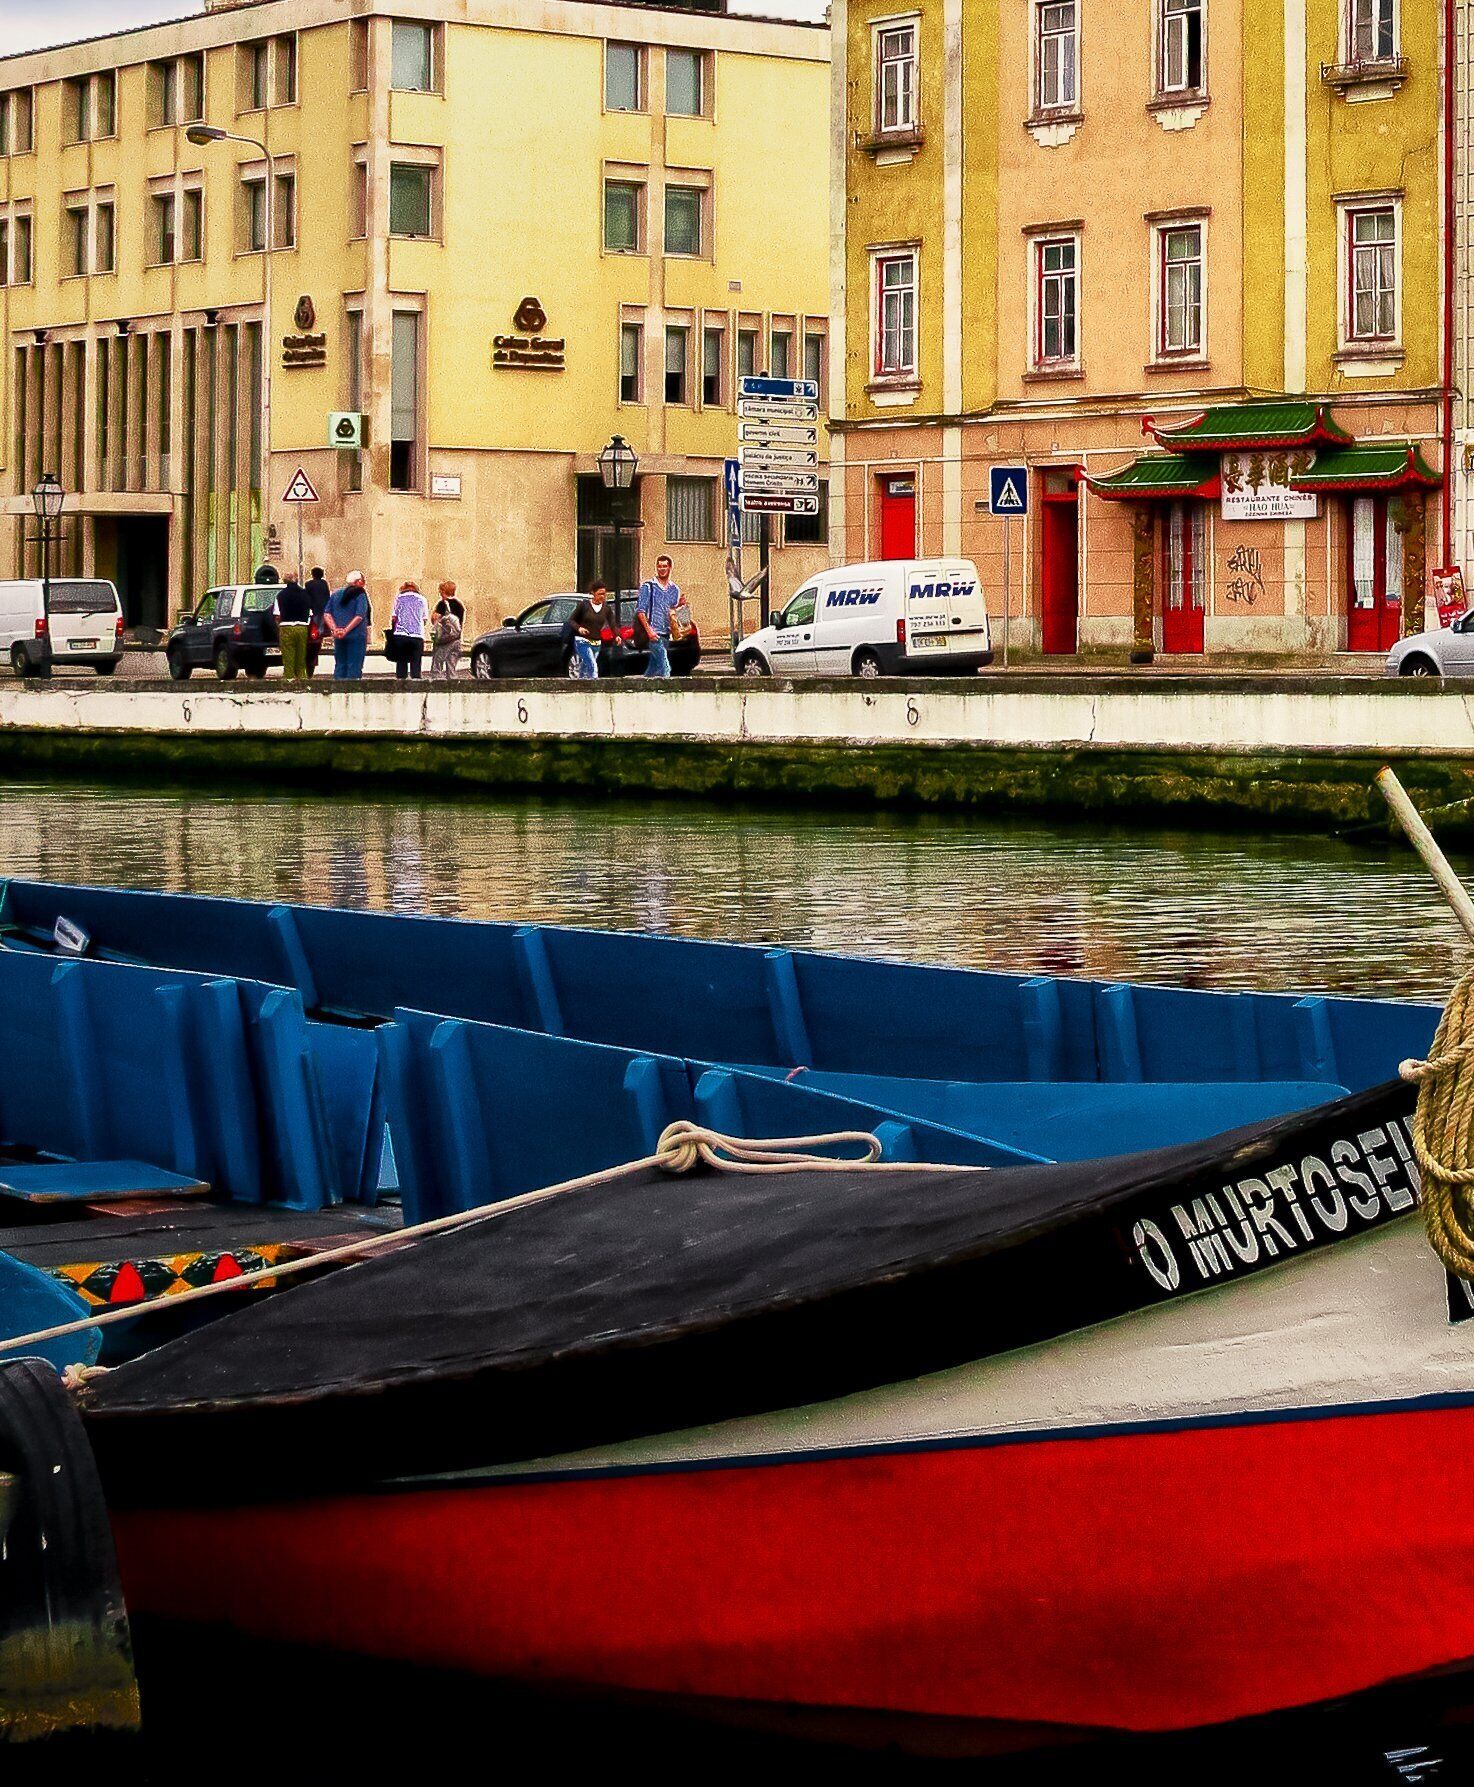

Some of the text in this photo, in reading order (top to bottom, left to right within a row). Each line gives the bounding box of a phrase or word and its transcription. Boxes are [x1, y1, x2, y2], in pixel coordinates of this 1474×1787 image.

[826, 588, 884, 607] MRW
[909, 581, 976, 599] MRW
[1133, 1218, 1180, 1291] O
